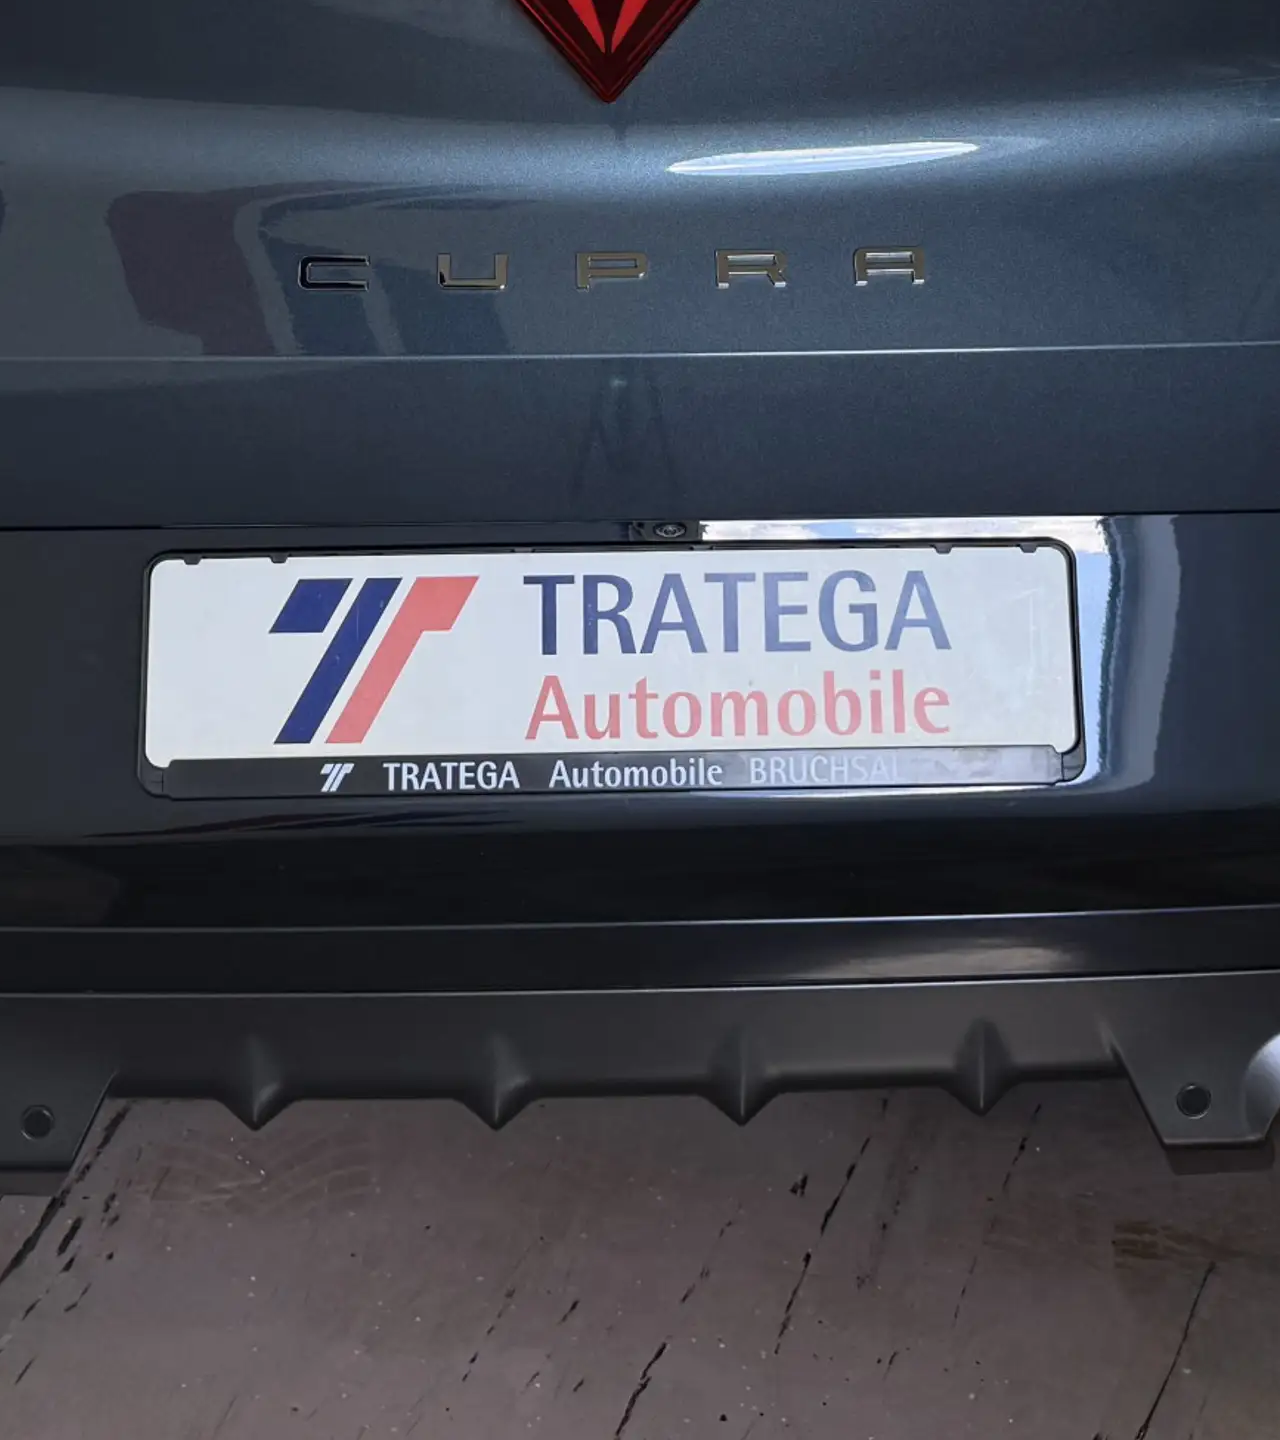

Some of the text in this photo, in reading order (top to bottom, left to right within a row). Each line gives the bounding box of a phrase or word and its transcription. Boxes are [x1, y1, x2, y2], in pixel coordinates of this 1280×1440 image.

[297, 246, 926, 292] CUPRA
[522, 569, 953, 656] TRATEGA
[524, 668, 952, 741] Automobile
[382, 753, 901, 792] TRATEGA Automobile BRUCHSAL
